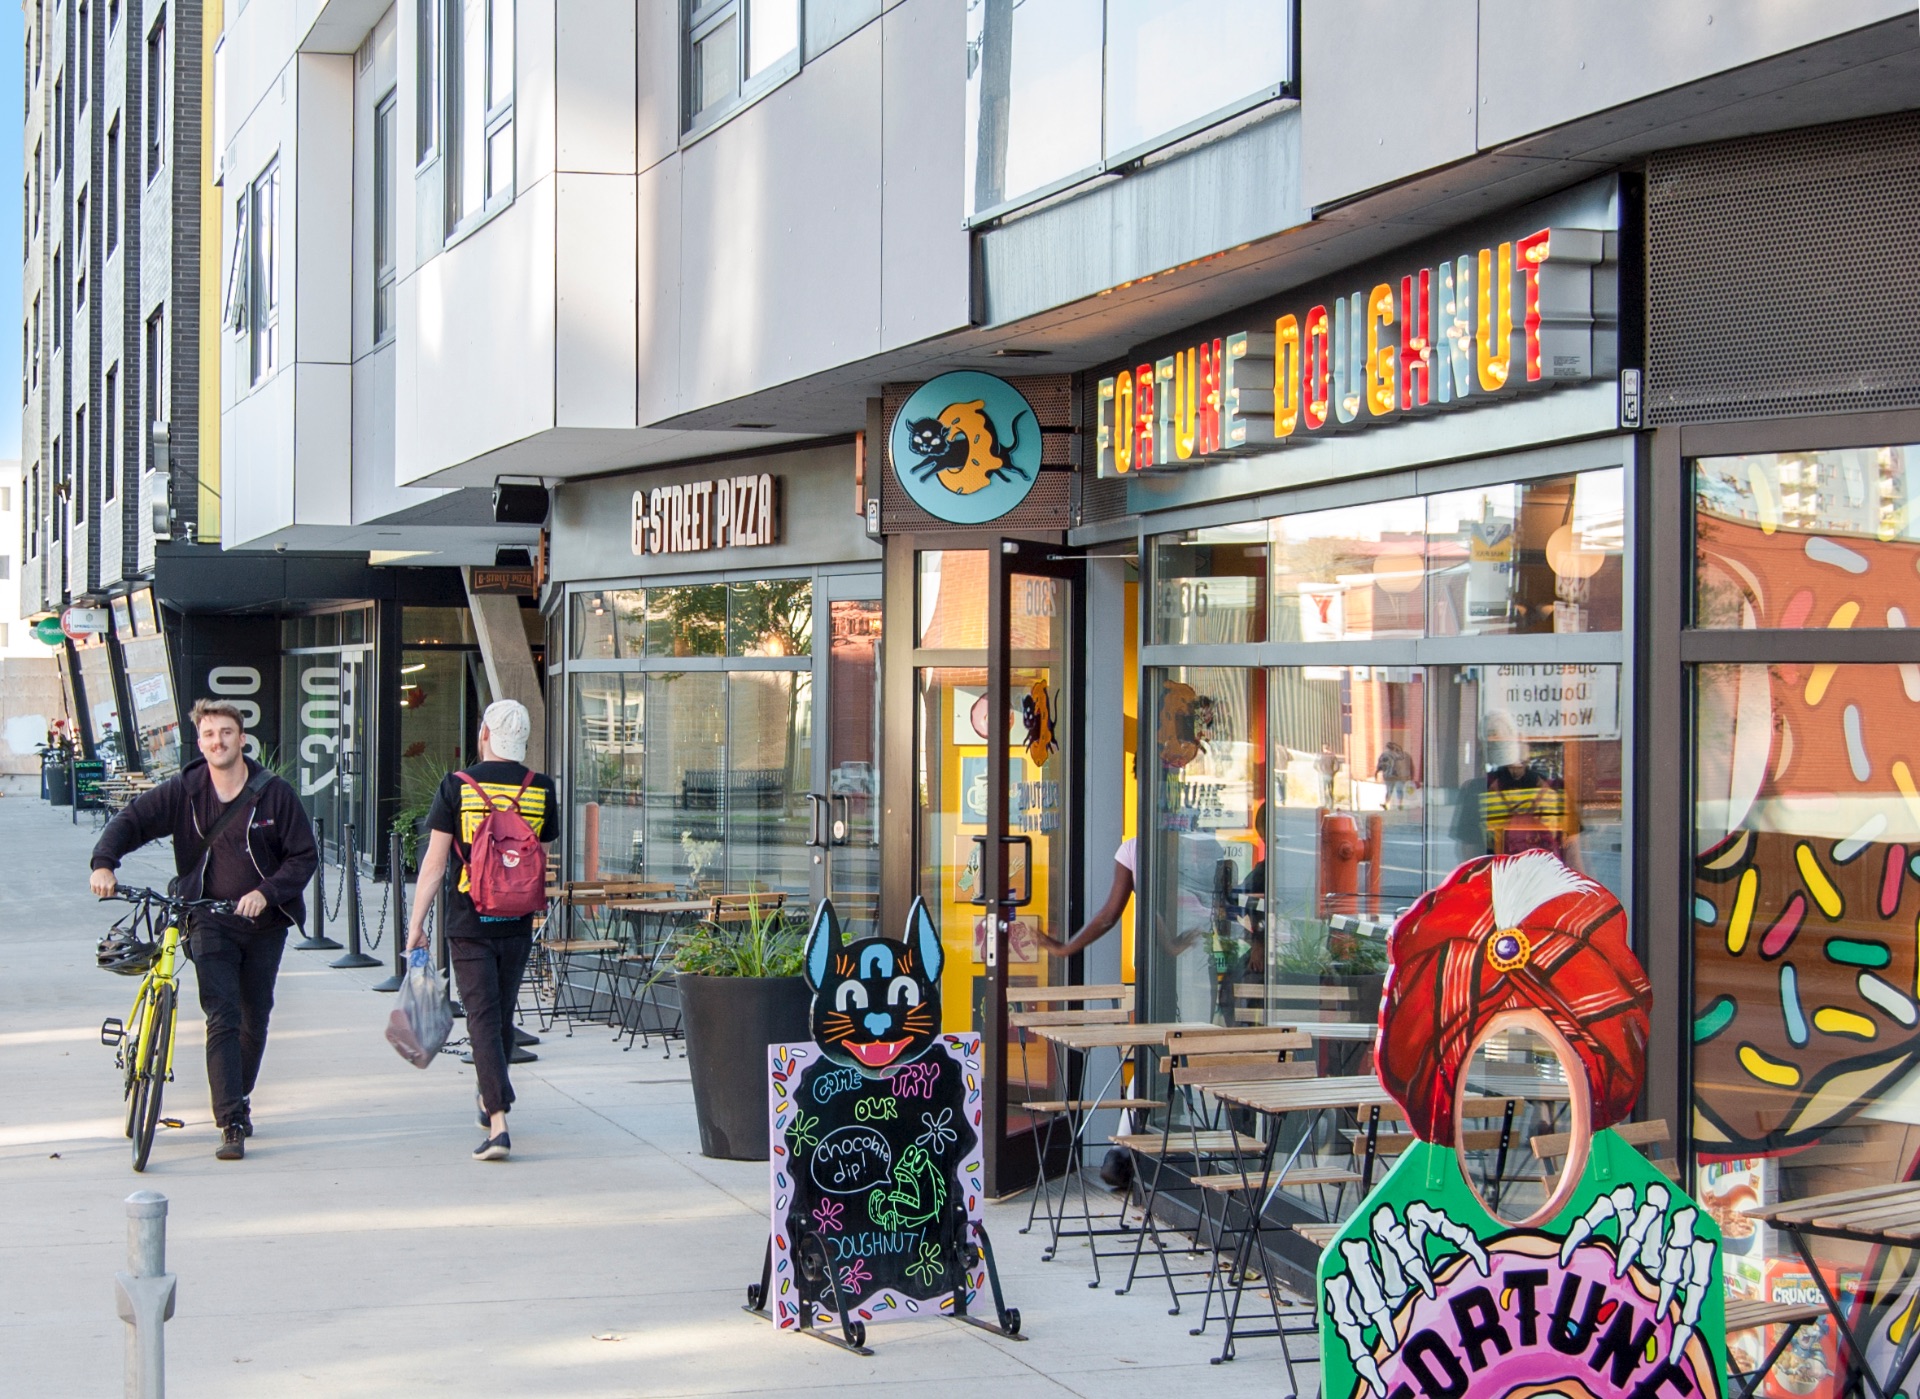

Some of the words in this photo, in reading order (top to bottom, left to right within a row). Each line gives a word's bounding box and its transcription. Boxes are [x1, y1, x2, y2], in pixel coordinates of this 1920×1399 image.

[1097, 331, 1248, 479] FORTUNE
[1274, 227, 1551, 438] DOUGHNUT
[631, 481, 713, 556] G-STREET
[717, 473, 773, 549] PIZZA
[512, 574, 532, 585] PIZZA
[813, 1066, 863, 1103] COME
[880, 1063, 940, 1098] TRY
[855, 1097, 898, 1121] OUR
